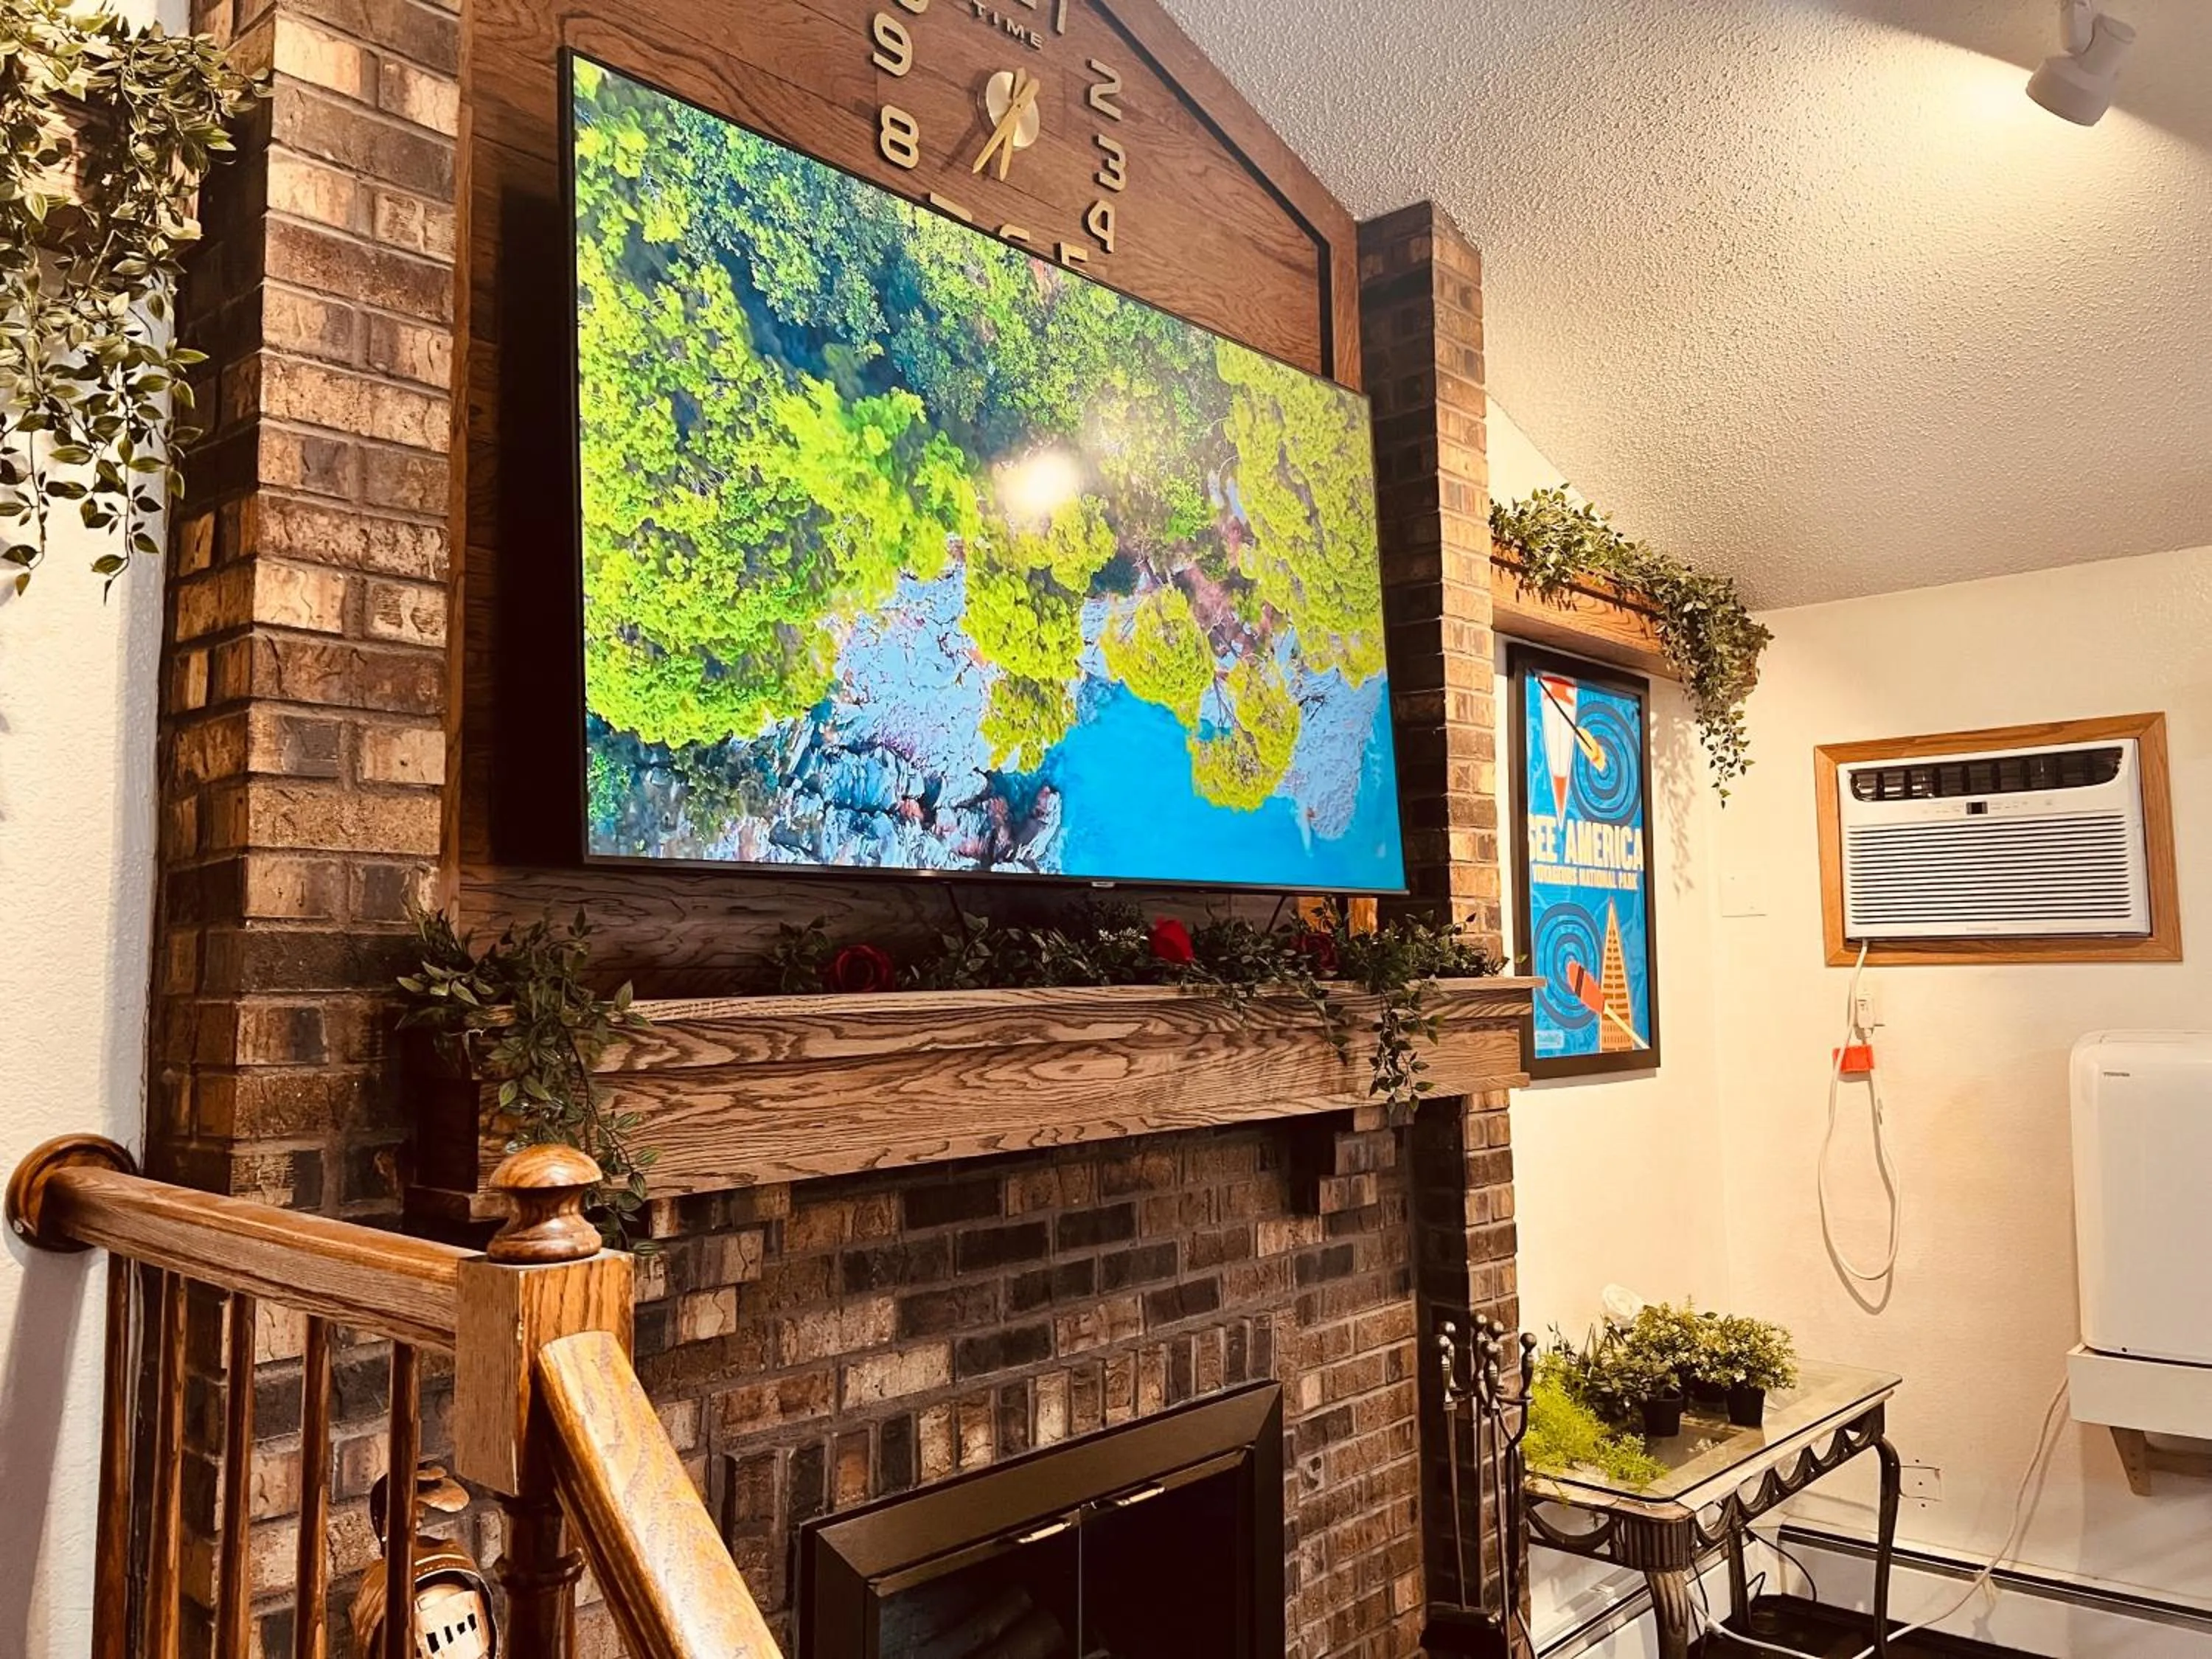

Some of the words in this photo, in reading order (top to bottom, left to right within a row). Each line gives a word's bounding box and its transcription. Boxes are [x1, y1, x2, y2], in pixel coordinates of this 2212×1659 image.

[873, 13, 913, 77] 9
[970, 0, 1043, 50] TIME
[1089, 58, 1122, 121] 2
[880, 105, 919, 169] 8
[1097, 134, 1127, 192] 3
[1088, 200, 1116, 253] 4
[1528, 814, 1558, 863] SEE
[1565, 819, 1644, 871] AMERICA
